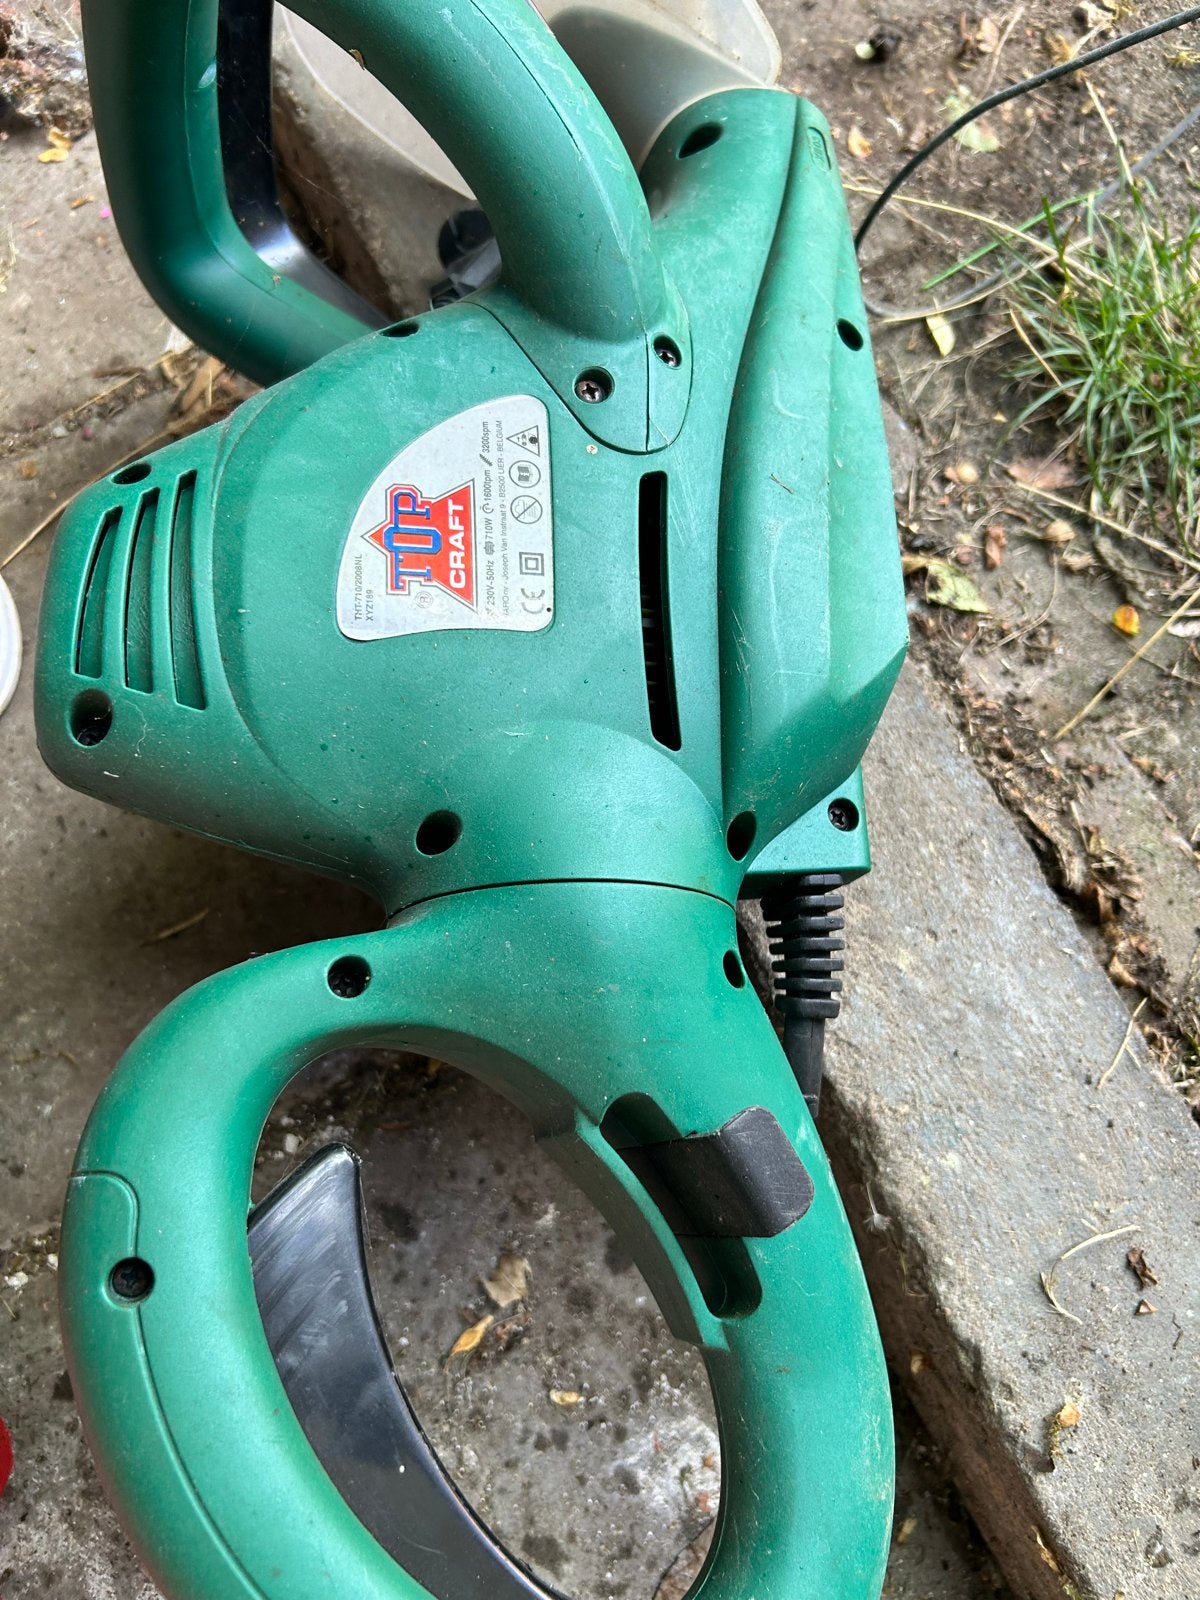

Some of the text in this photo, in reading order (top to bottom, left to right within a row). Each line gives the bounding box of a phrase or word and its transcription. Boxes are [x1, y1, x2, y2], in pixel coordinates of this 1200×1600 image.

[481, 421, 491, 453] 3200spm
[496, 420, 504, 452] BELGIUM
[498, 475, 506, 498] B2500
[383, 490, 442, 590] TOP
[447, 499, 466, 588] CRAFT
[484, 517, 493, 540] 710W
[365, 589, 374, 621] XYZ189
